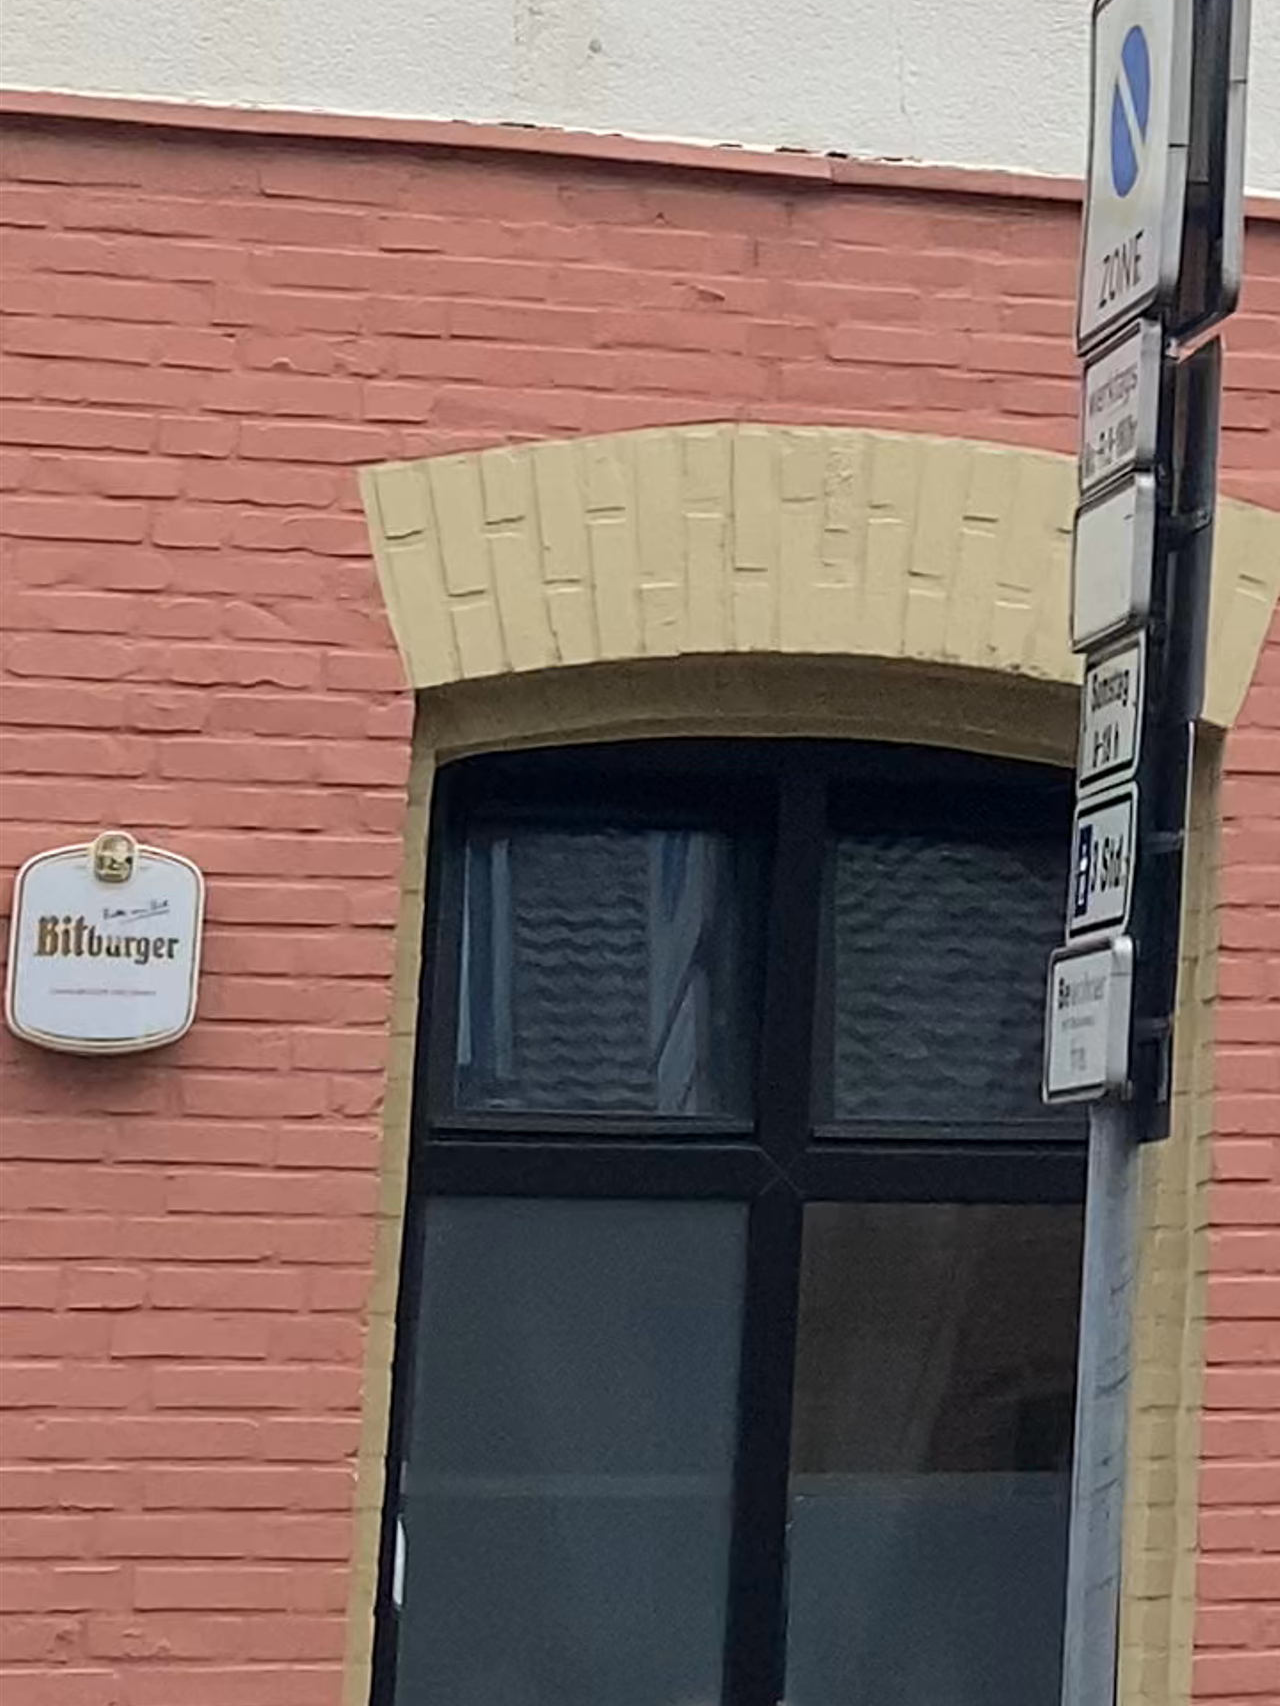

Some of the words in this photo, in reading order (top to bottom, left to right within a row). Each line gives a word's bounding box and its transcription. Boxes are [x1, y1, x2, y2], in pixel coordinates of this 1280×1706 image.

[1098, 228, 1145, 309] ZONE
[1091, 669, 1130, 712] Samstag
[34, 913, 180, 966] Bitburger
